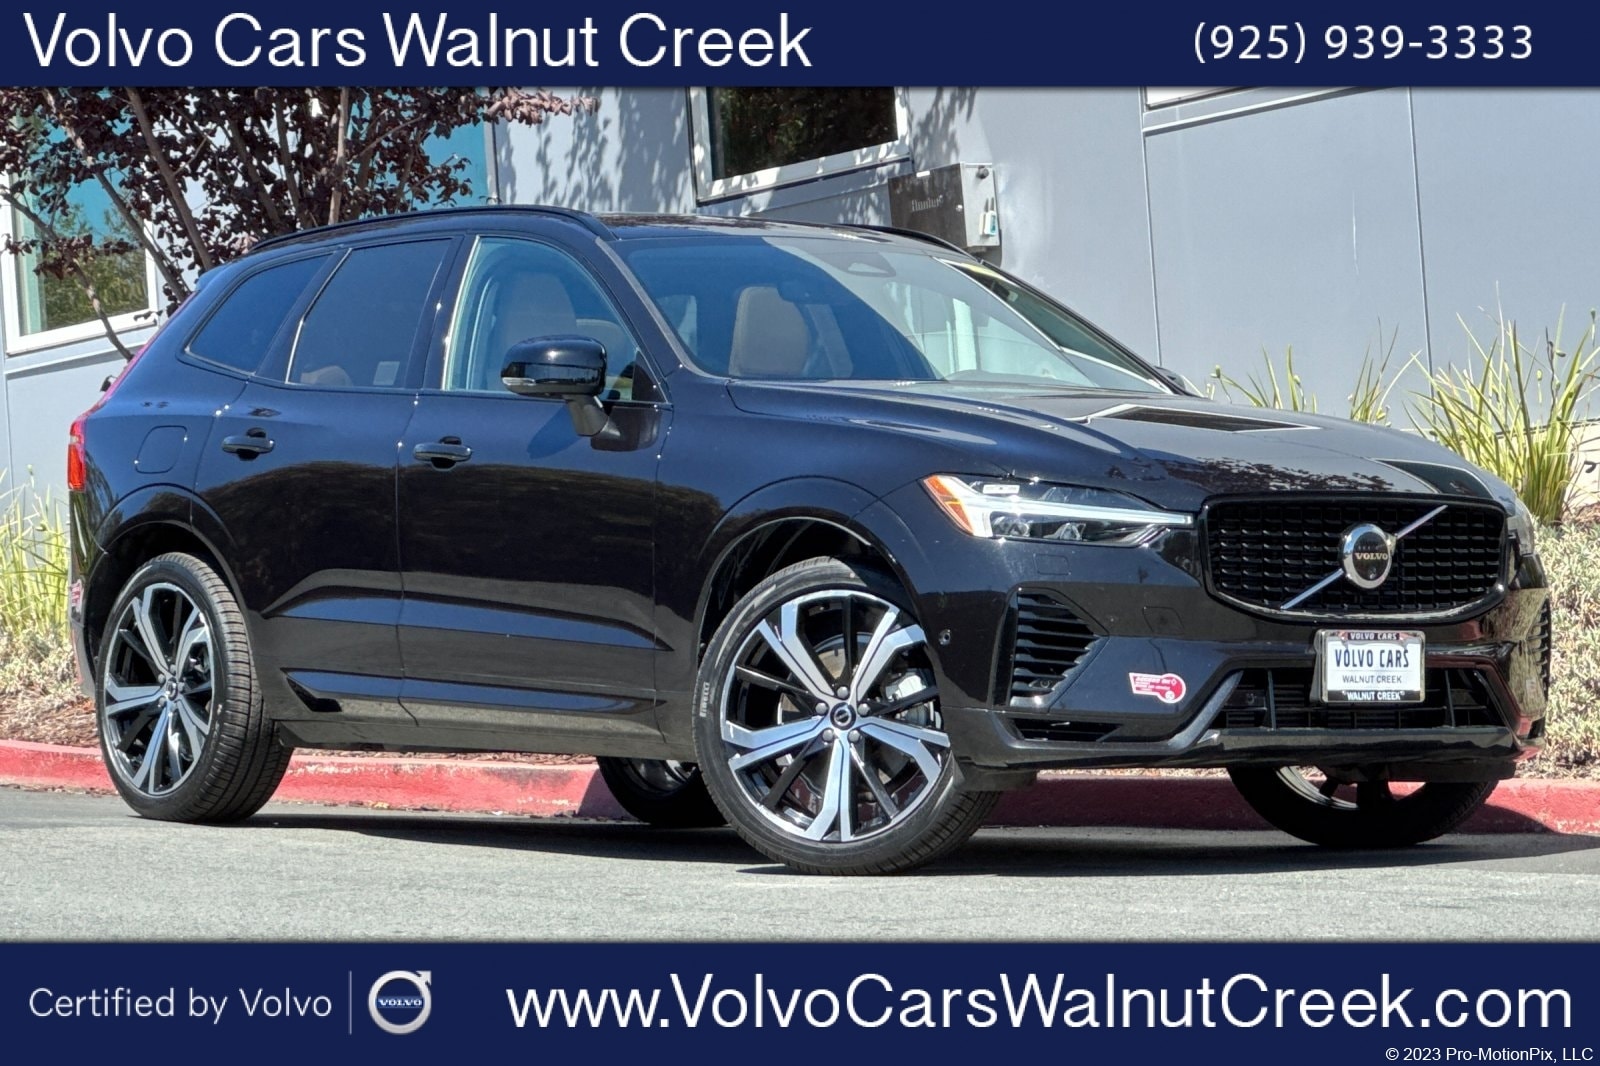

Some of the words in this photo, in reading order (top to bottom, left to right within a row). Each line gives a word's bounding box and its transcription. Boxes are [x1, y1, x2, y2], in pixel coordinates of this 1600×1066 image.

[1354, 552, 1388, 560] VOLVO
[1350, 632, 1374, 641] VOLVO
[1377, 632, 1397, 641] CARS
[1335, 649, 1373, 668] VOLVO
[1379, 649, 1409, 668] CARS
[1342, 674, 1375, 684] WALNUT
[1376, 675, 1402, 684] CREEK
[1346, 691, 1375, 701] WALNUT
[1376, 691, 1401, 701] CREEK
